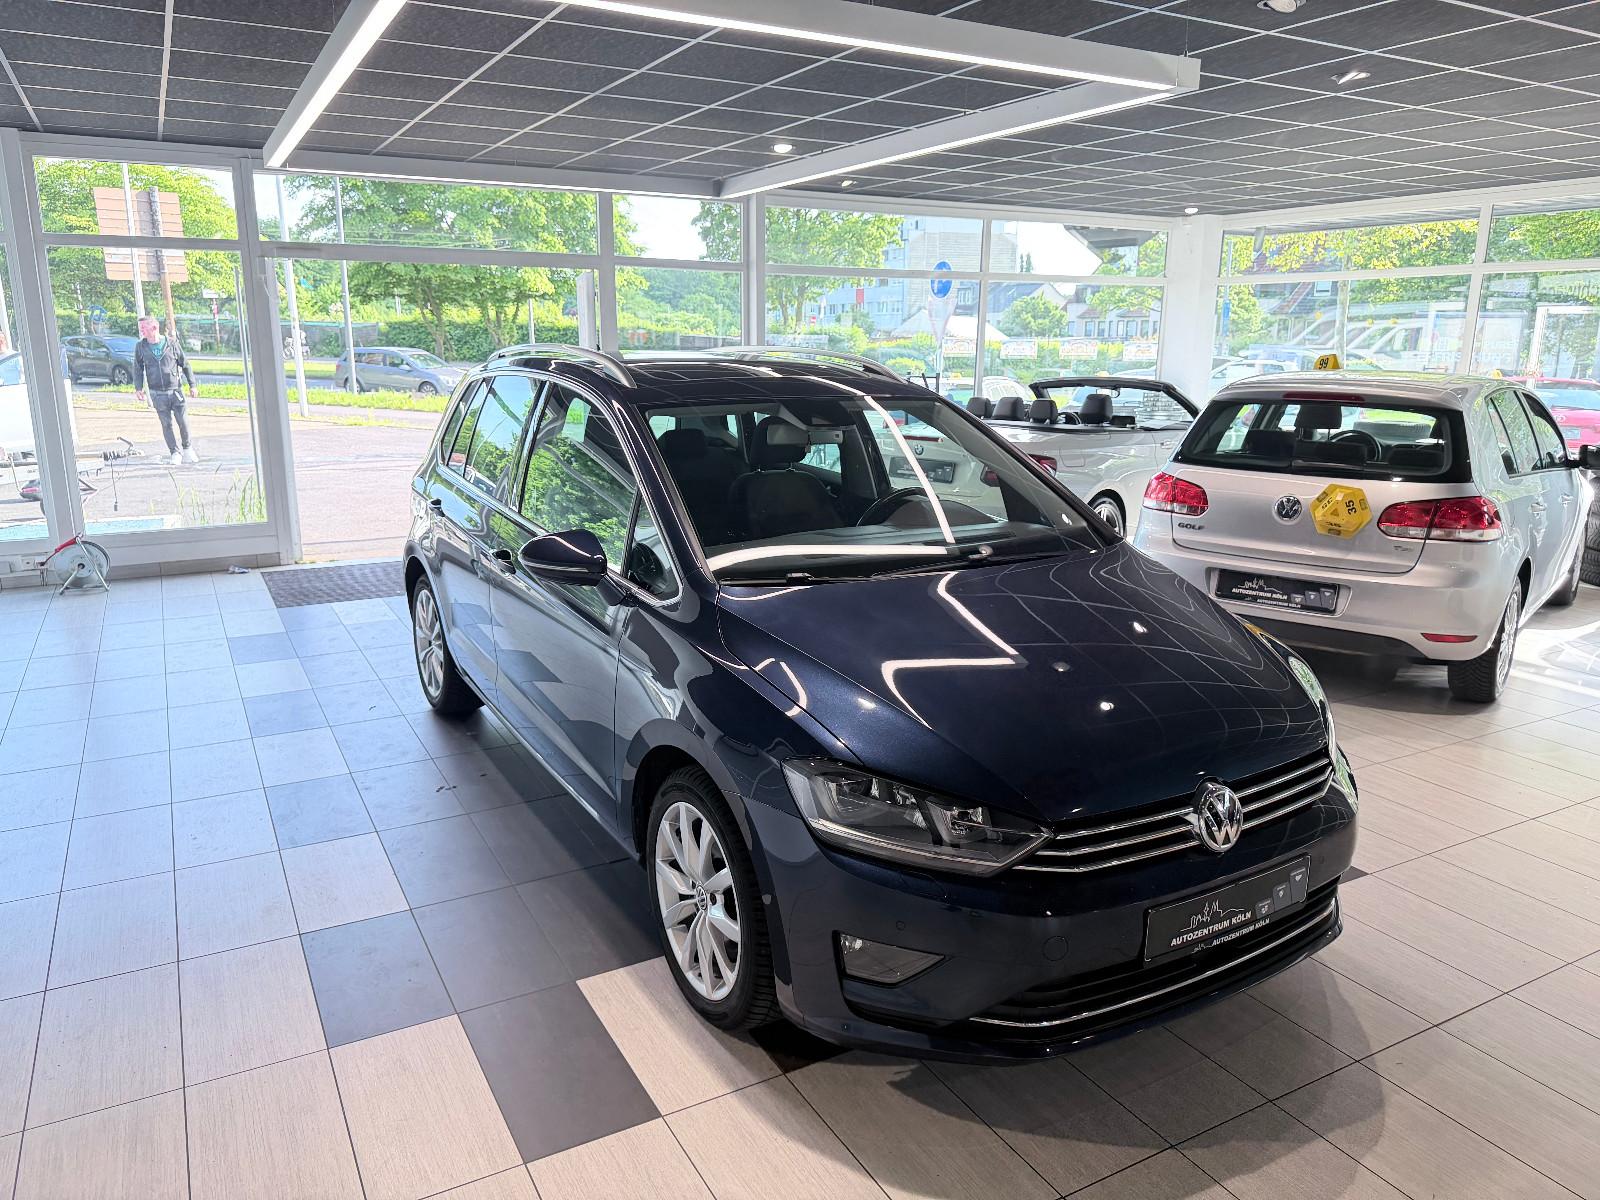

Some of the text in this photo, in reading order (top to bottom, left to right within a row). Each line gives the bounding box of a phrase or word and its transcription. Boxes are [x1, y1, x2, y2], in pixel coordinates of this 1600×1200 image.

[1345, 499, 1357, 515] 35
[1177, 522, 1205, 531] GOLF
[1231, 588, 1288, 600] AUTOZENTRUM KÖLN
[1170, 910, 1252, 947] AUTOZENTRUM KÖLN
[1211, 917, 1270, 946] AUTOZENTRUM KÖLN
